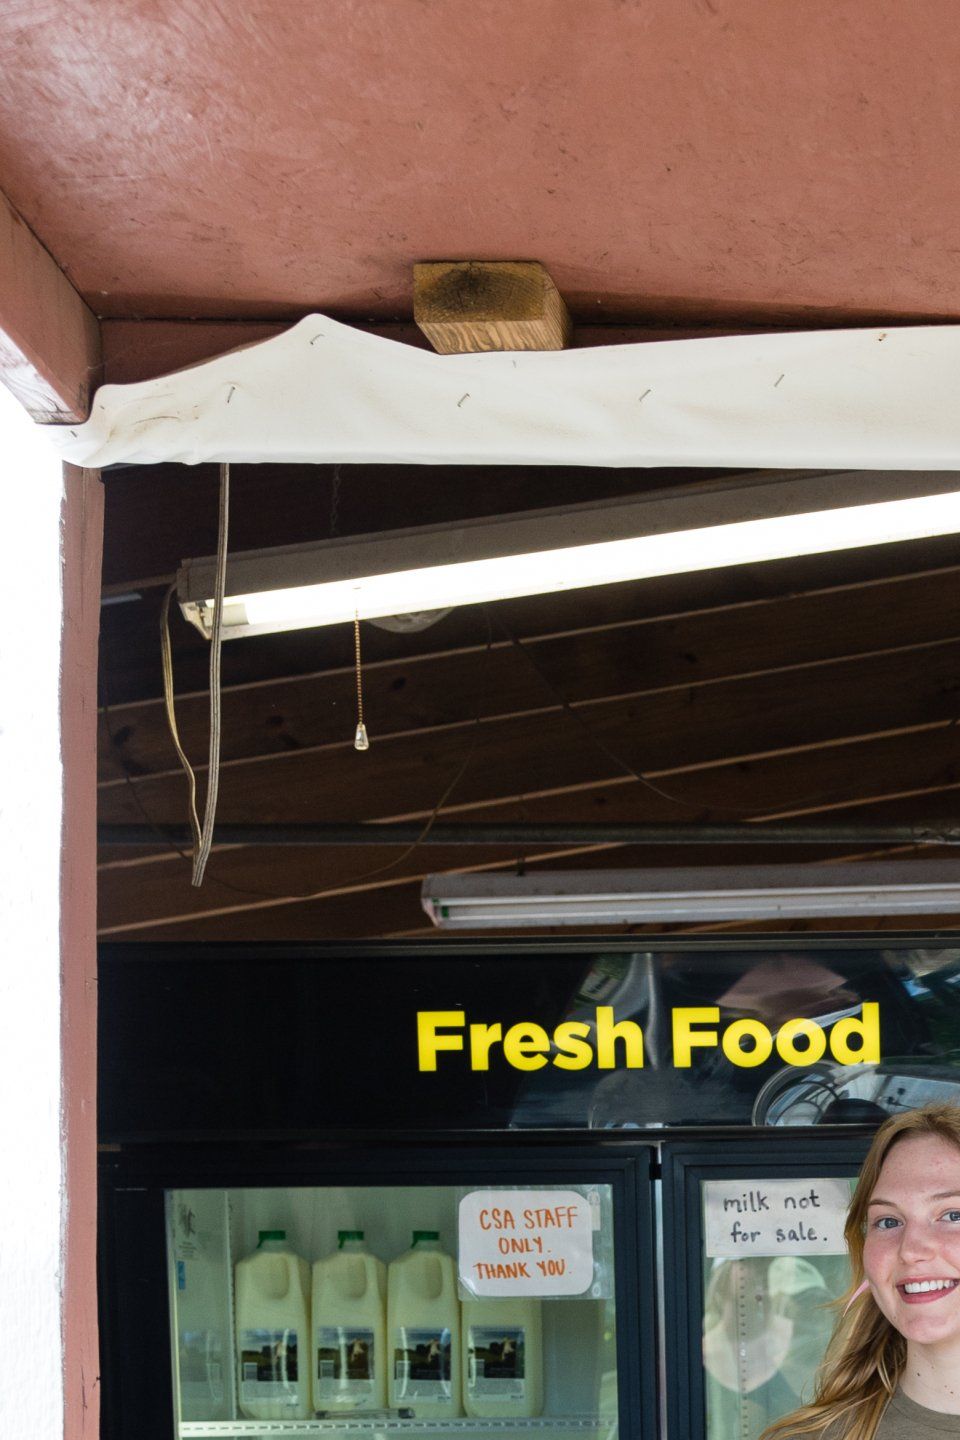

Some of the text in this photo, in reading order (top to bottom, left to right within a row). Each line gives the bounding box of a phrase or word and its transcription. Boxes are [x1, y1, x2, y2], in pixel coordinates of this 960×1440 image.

[416, 1002, 881, 1073] Fresh Food
[723, 1189, 820, 1213] milk not
[480, 1206, 578, 1231] CSA STAFF
[730, 1221, 828, 1243] for sale.
[498, 1236, 552, 1255] ONLY.
[472, 1261, 532, 1280] THANK
